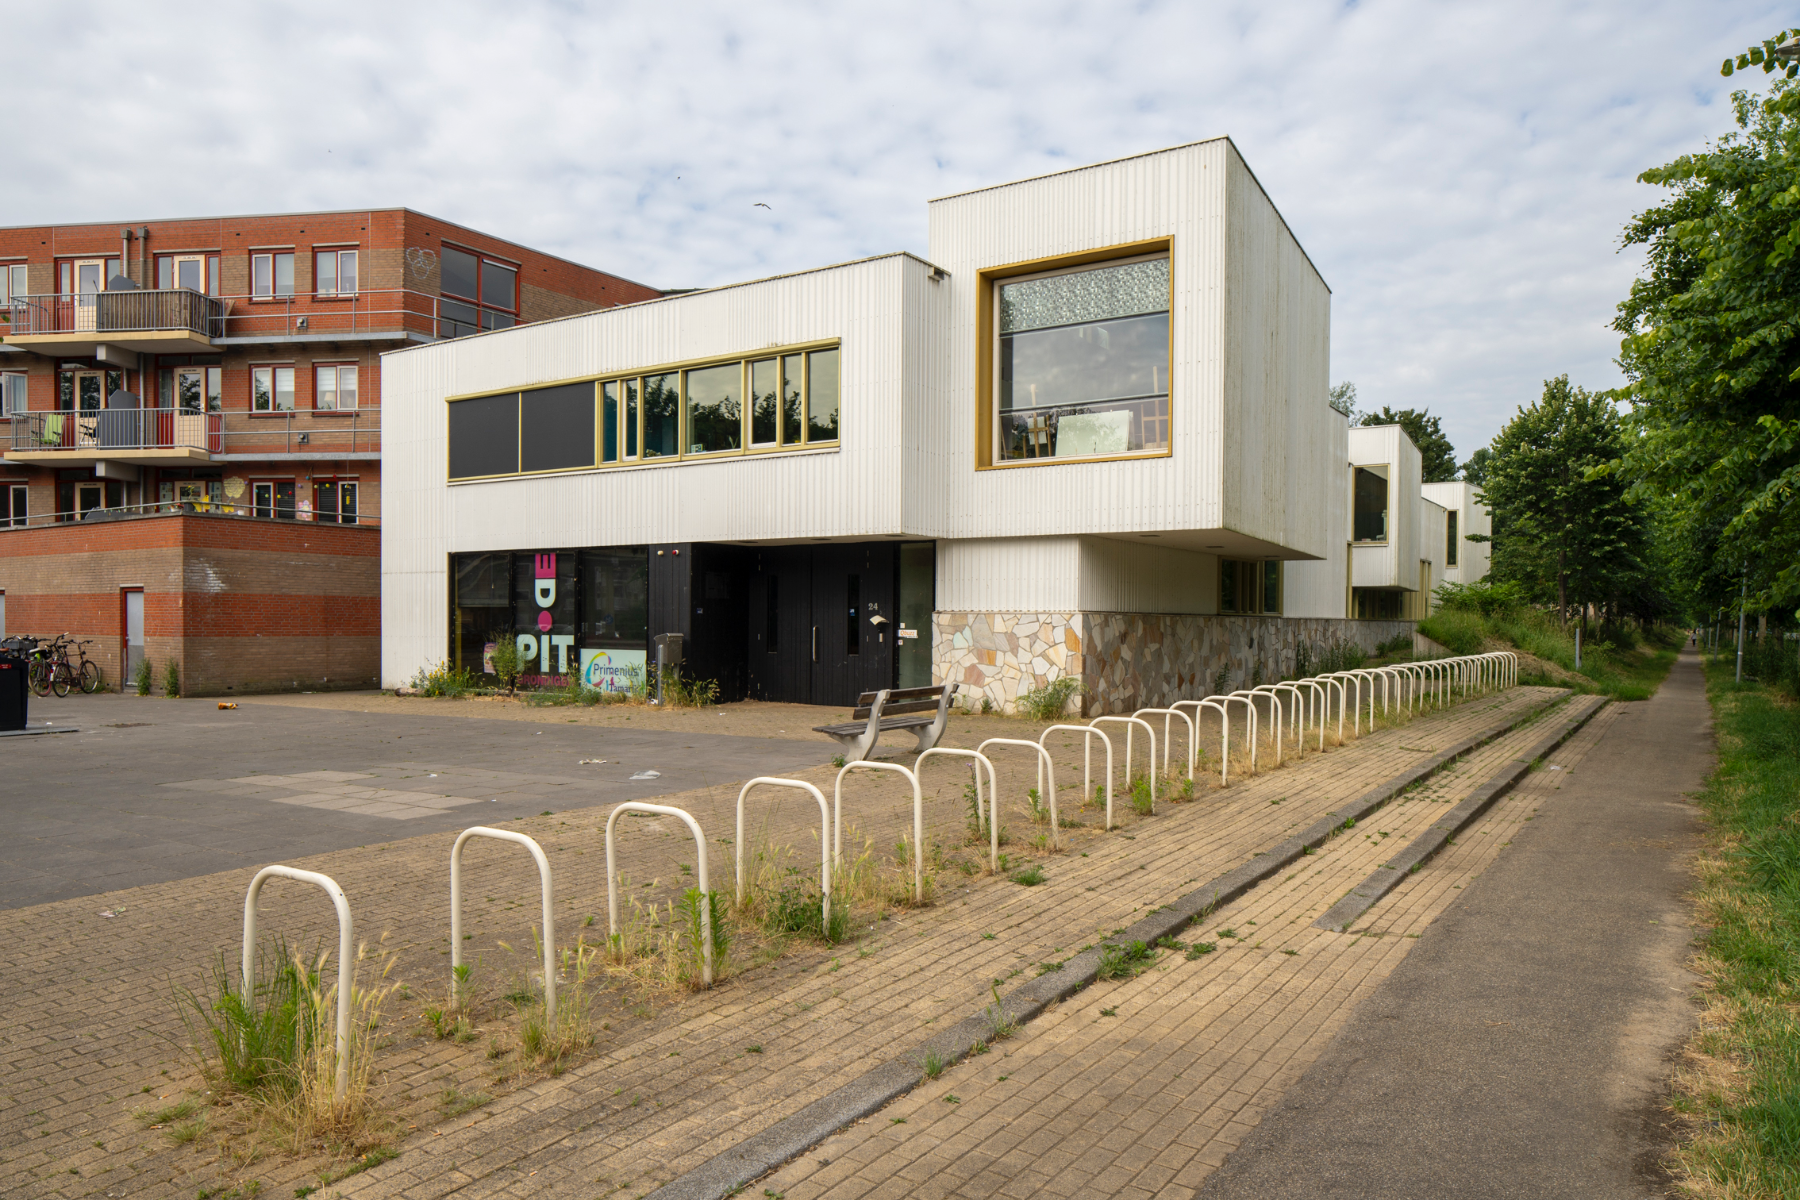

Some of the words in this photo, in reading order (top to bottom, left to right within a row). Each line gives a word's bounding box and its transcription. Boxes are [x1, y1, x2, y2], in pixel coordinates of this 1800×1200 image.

[868, 602, 878, 610] 24
[516, 634, 574, 673] PIT
[593, 663, 639, 676] Primenius
[517, 674, 574, 687] GRONINGE
